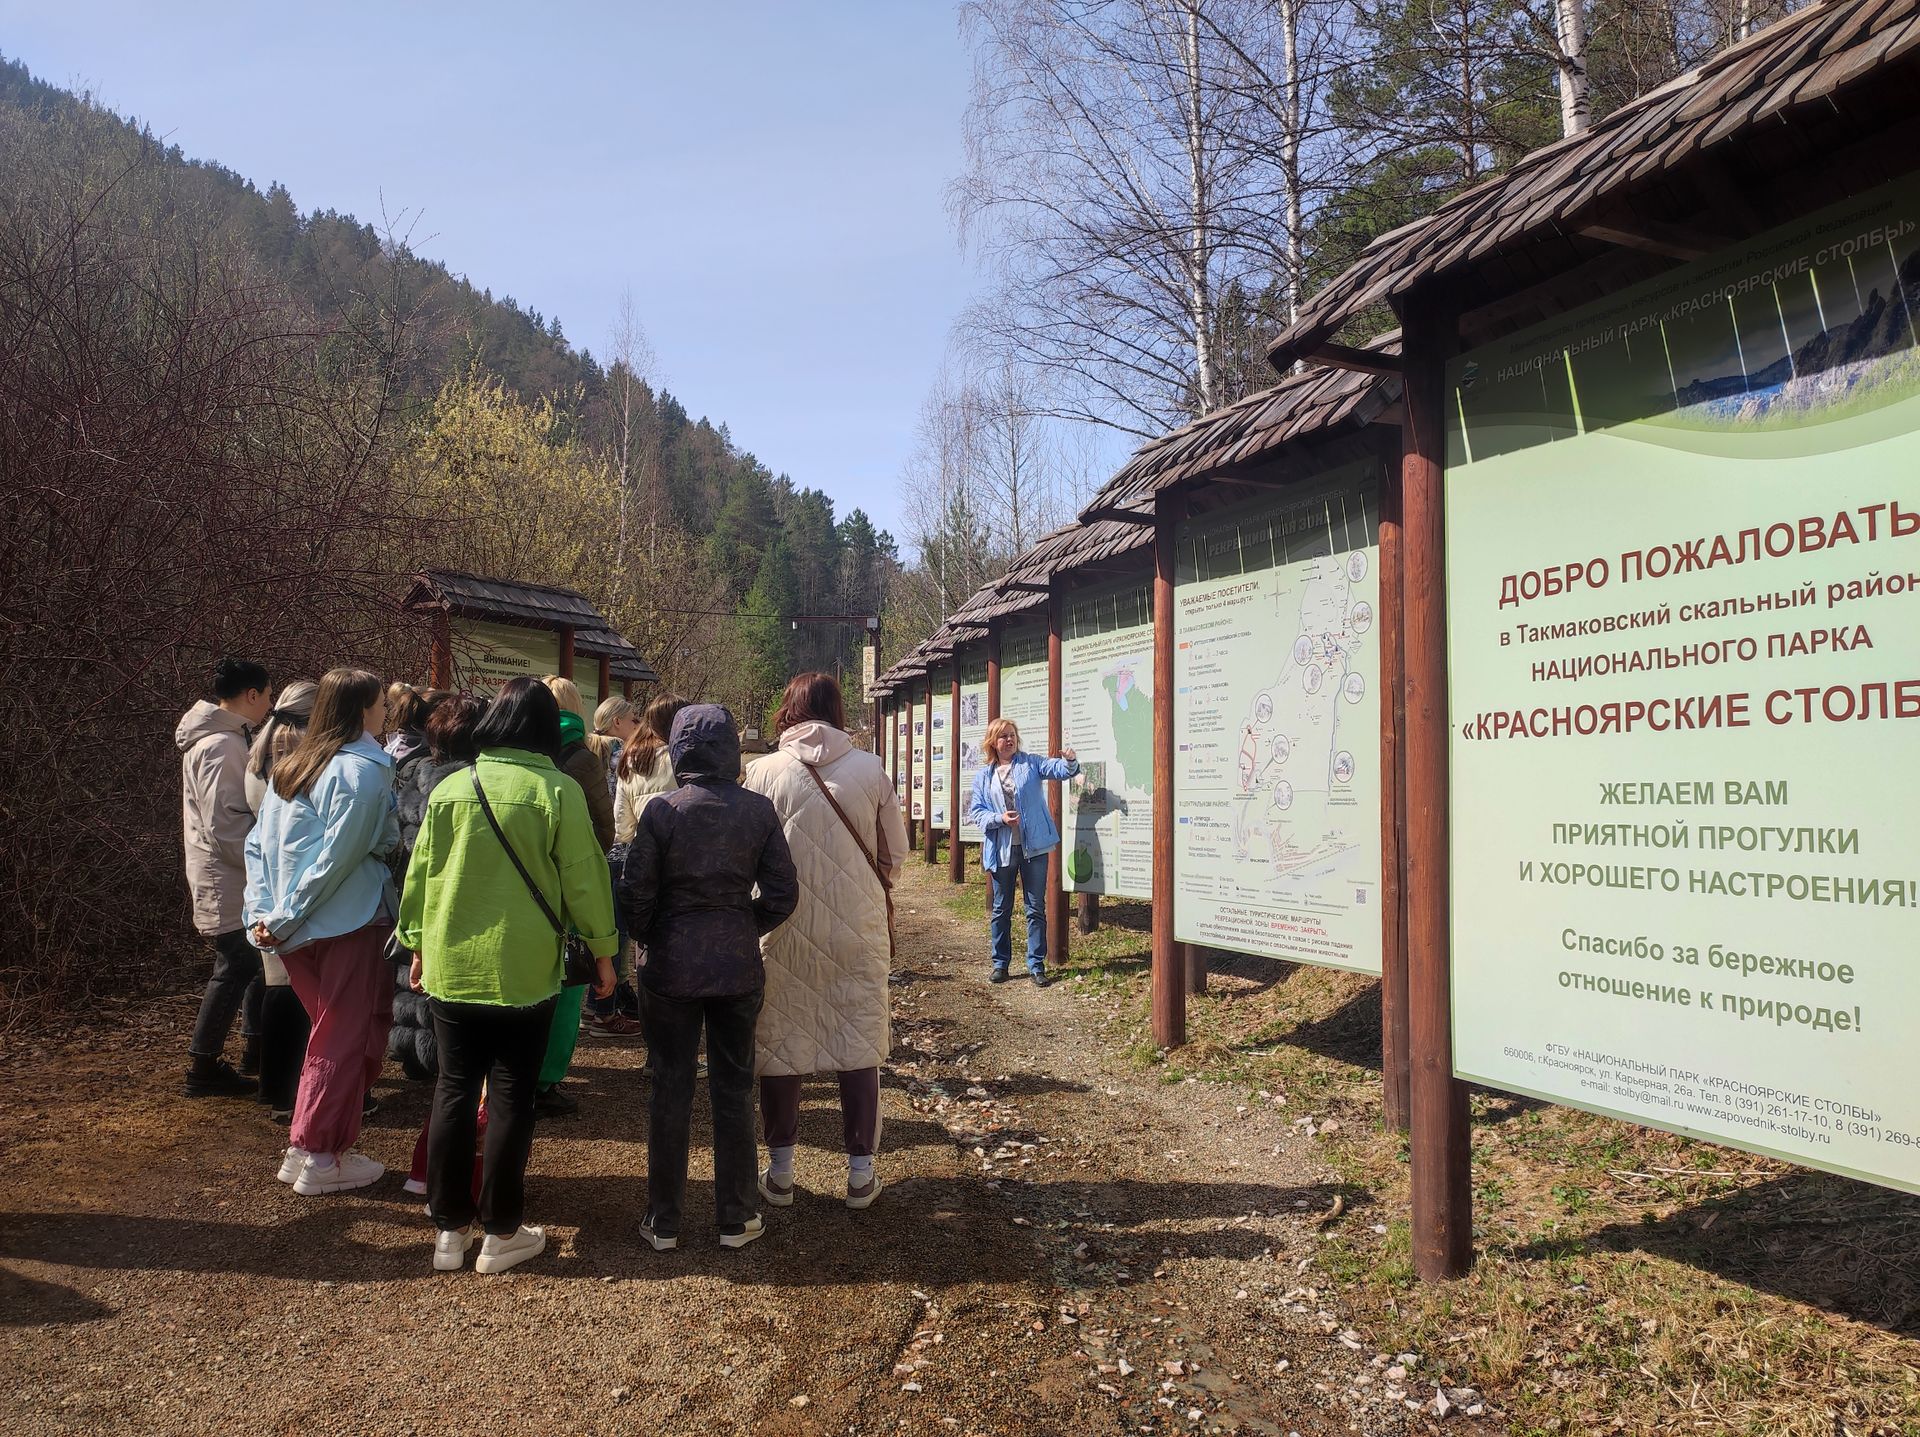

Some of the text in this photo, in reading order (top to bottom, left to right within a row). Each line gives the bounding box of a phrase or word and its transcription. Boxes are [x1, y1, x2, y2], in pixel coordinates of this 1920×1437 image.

[1497, 219, 1916, 383] НАЦИОНАЛЬНЫЙ ПАРК «КРАСНОЯРСКИЕ СТОЛБЫ»
[1499, 501, 1920, 609] ДОБРО ПОЖАЛОВАТЬ
[1180, 581, 1261, 608] УВАЖАЕМЫЕ ПОСЕТИТЕЛИ,
[1500, 631, 1511, 646] в
[1516, 603, 1671, 645] Такмаковский
[1679, 581, 1816, 622] скальный
[483, 654, 531, 668] ВНИМАНИЕ!
[1531, 624, 1874, 682] НАЦИОНАЛЬНОГО ПАРКА
[1462, 692, 1750, 741] «КРАСНОЯРСКИЕ
[1599, 780, 1788, 806] ЖЕЛАЕМ ВАМ
[1552, 820, 1859, 855] ПРИЯТНОЙ ПРОГУЛКИ
[1518, 861, 1917, 908] И ХОРОШЕГО НАСТРОЕНИЯ!
[1214, 914, 1253, 925] РЕКРЕАЦИОННОЙ
[1254, 920, 1270, 928] ЗОНЫ
[1271, 922, 1298, 932] ВРЕМЕННО
[1220, 906, 1321, 926] ОСТАЛЬНЫЕ ТУРИСТИЧЕСКИЕ МАРШРУТЫ
[1561, 928, 1855, 985] Спасибо за бережное
[1558, 969, 1862, 1033] отношение к природе!
[1503, 1046, 1536, 1064] 660006,
[1538, 1055, 1596, 1078] г.Красноярск,
[1598, 1068, 1613, 1080] ул.
[1615, 1071, 1671, 1094] Карьерная,
[1699, 1089, 1721, 1104] Тел.
[1724, 1095, 1732, 1106] 8
[1734, 1096, 1764, 1115] (391)
[1767, 1104, 1832, 1130] 261-17-10,
[1835, 1119, 1844, 1131] 8
[1847, 1121, 1882, 1142] (391)
[1545, 1042, 1882, 1123] ФГБУ «НАЦИОНАЛЬНЫЙ ПАРК «КРАСНОЯРСКИЕ СТОЛБЫ»
[1580, 1078, 1831, 1145] e-mail: stolby@mail.ru www.zapovednik-stolby.ru
